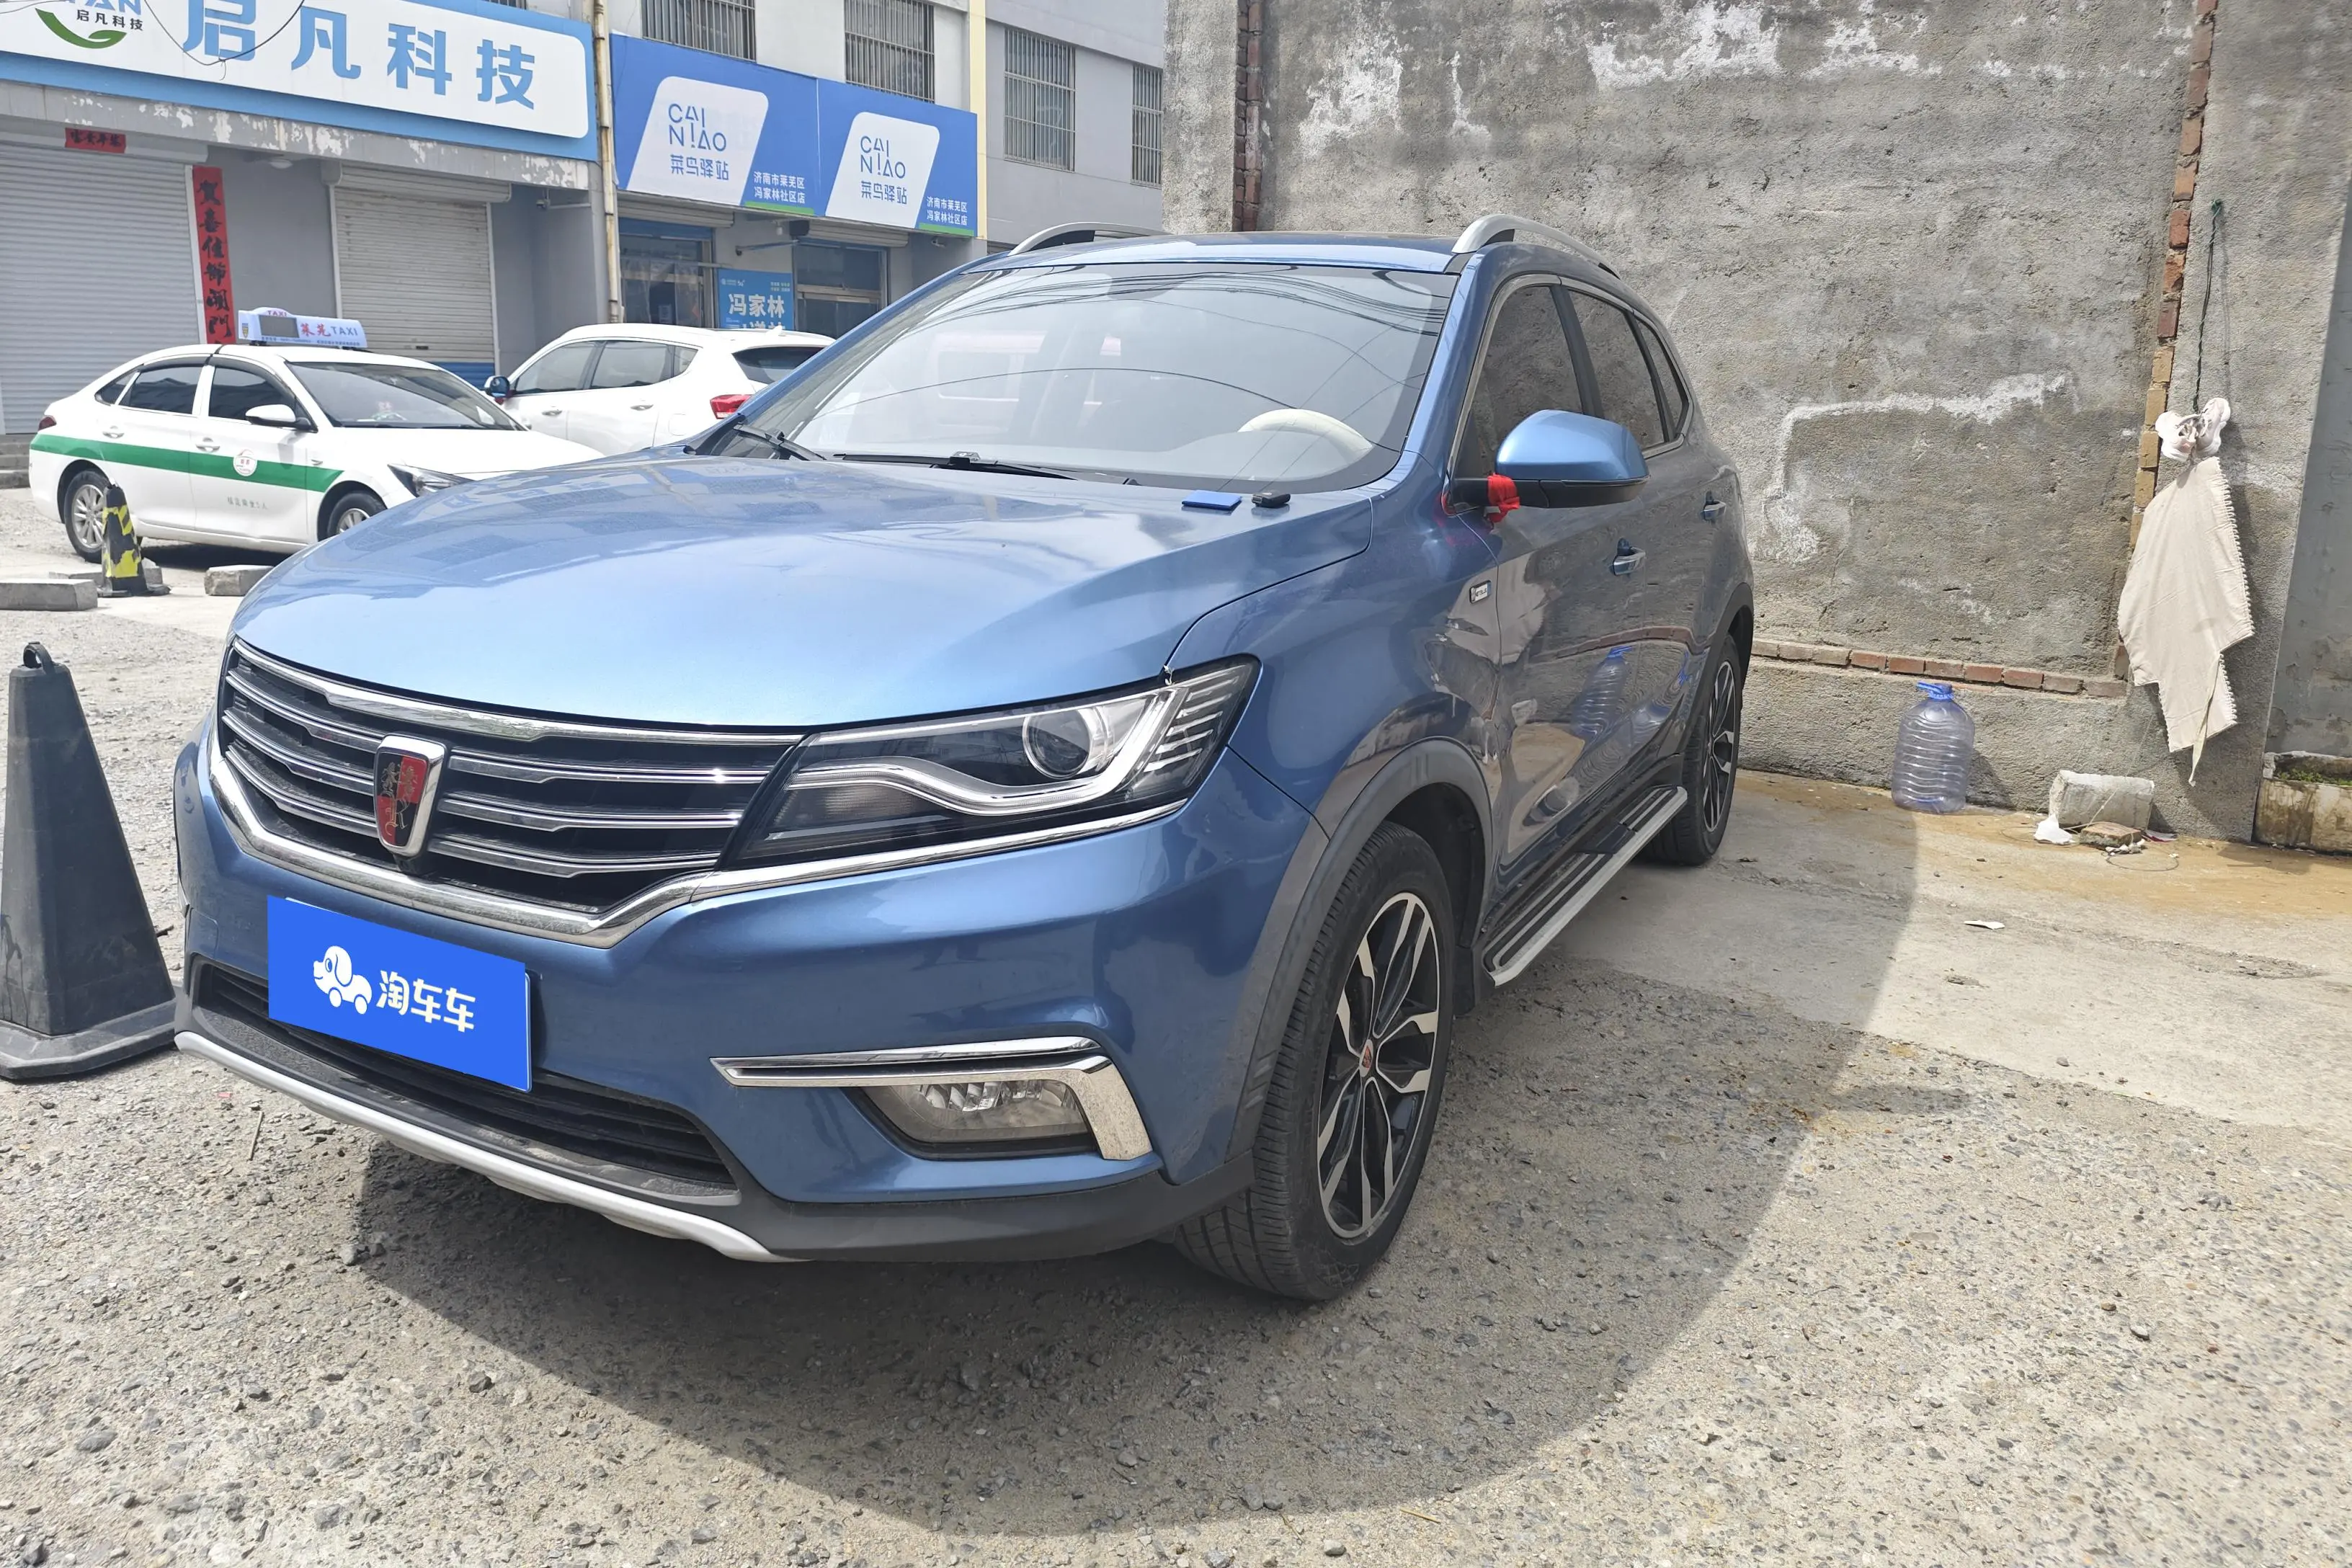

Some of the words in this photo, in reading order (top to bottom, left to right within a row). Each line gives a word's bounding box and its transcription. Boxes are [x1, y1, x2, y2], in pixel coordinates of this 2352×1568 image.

[76, 9, 144, 31] 启凡科技
[182, 0, 535, 110] 启凡科技
[668, 103, 705, 128] CAI
[860, 135, 889, 158] CAI
[670, 154, 729, 181] 菜鸟驿站
[753, 171, 805, 190] 济南市莱芜区
[754, 187, 806, 205] 冯家林社区店
[860, 180, 907, 205] 菜鸟驿站
[927, 210, 968, 226] 冯家林社区店
[728, 293, 785, 318] 冯家林
[330, 326, 359, 337] TAXI
